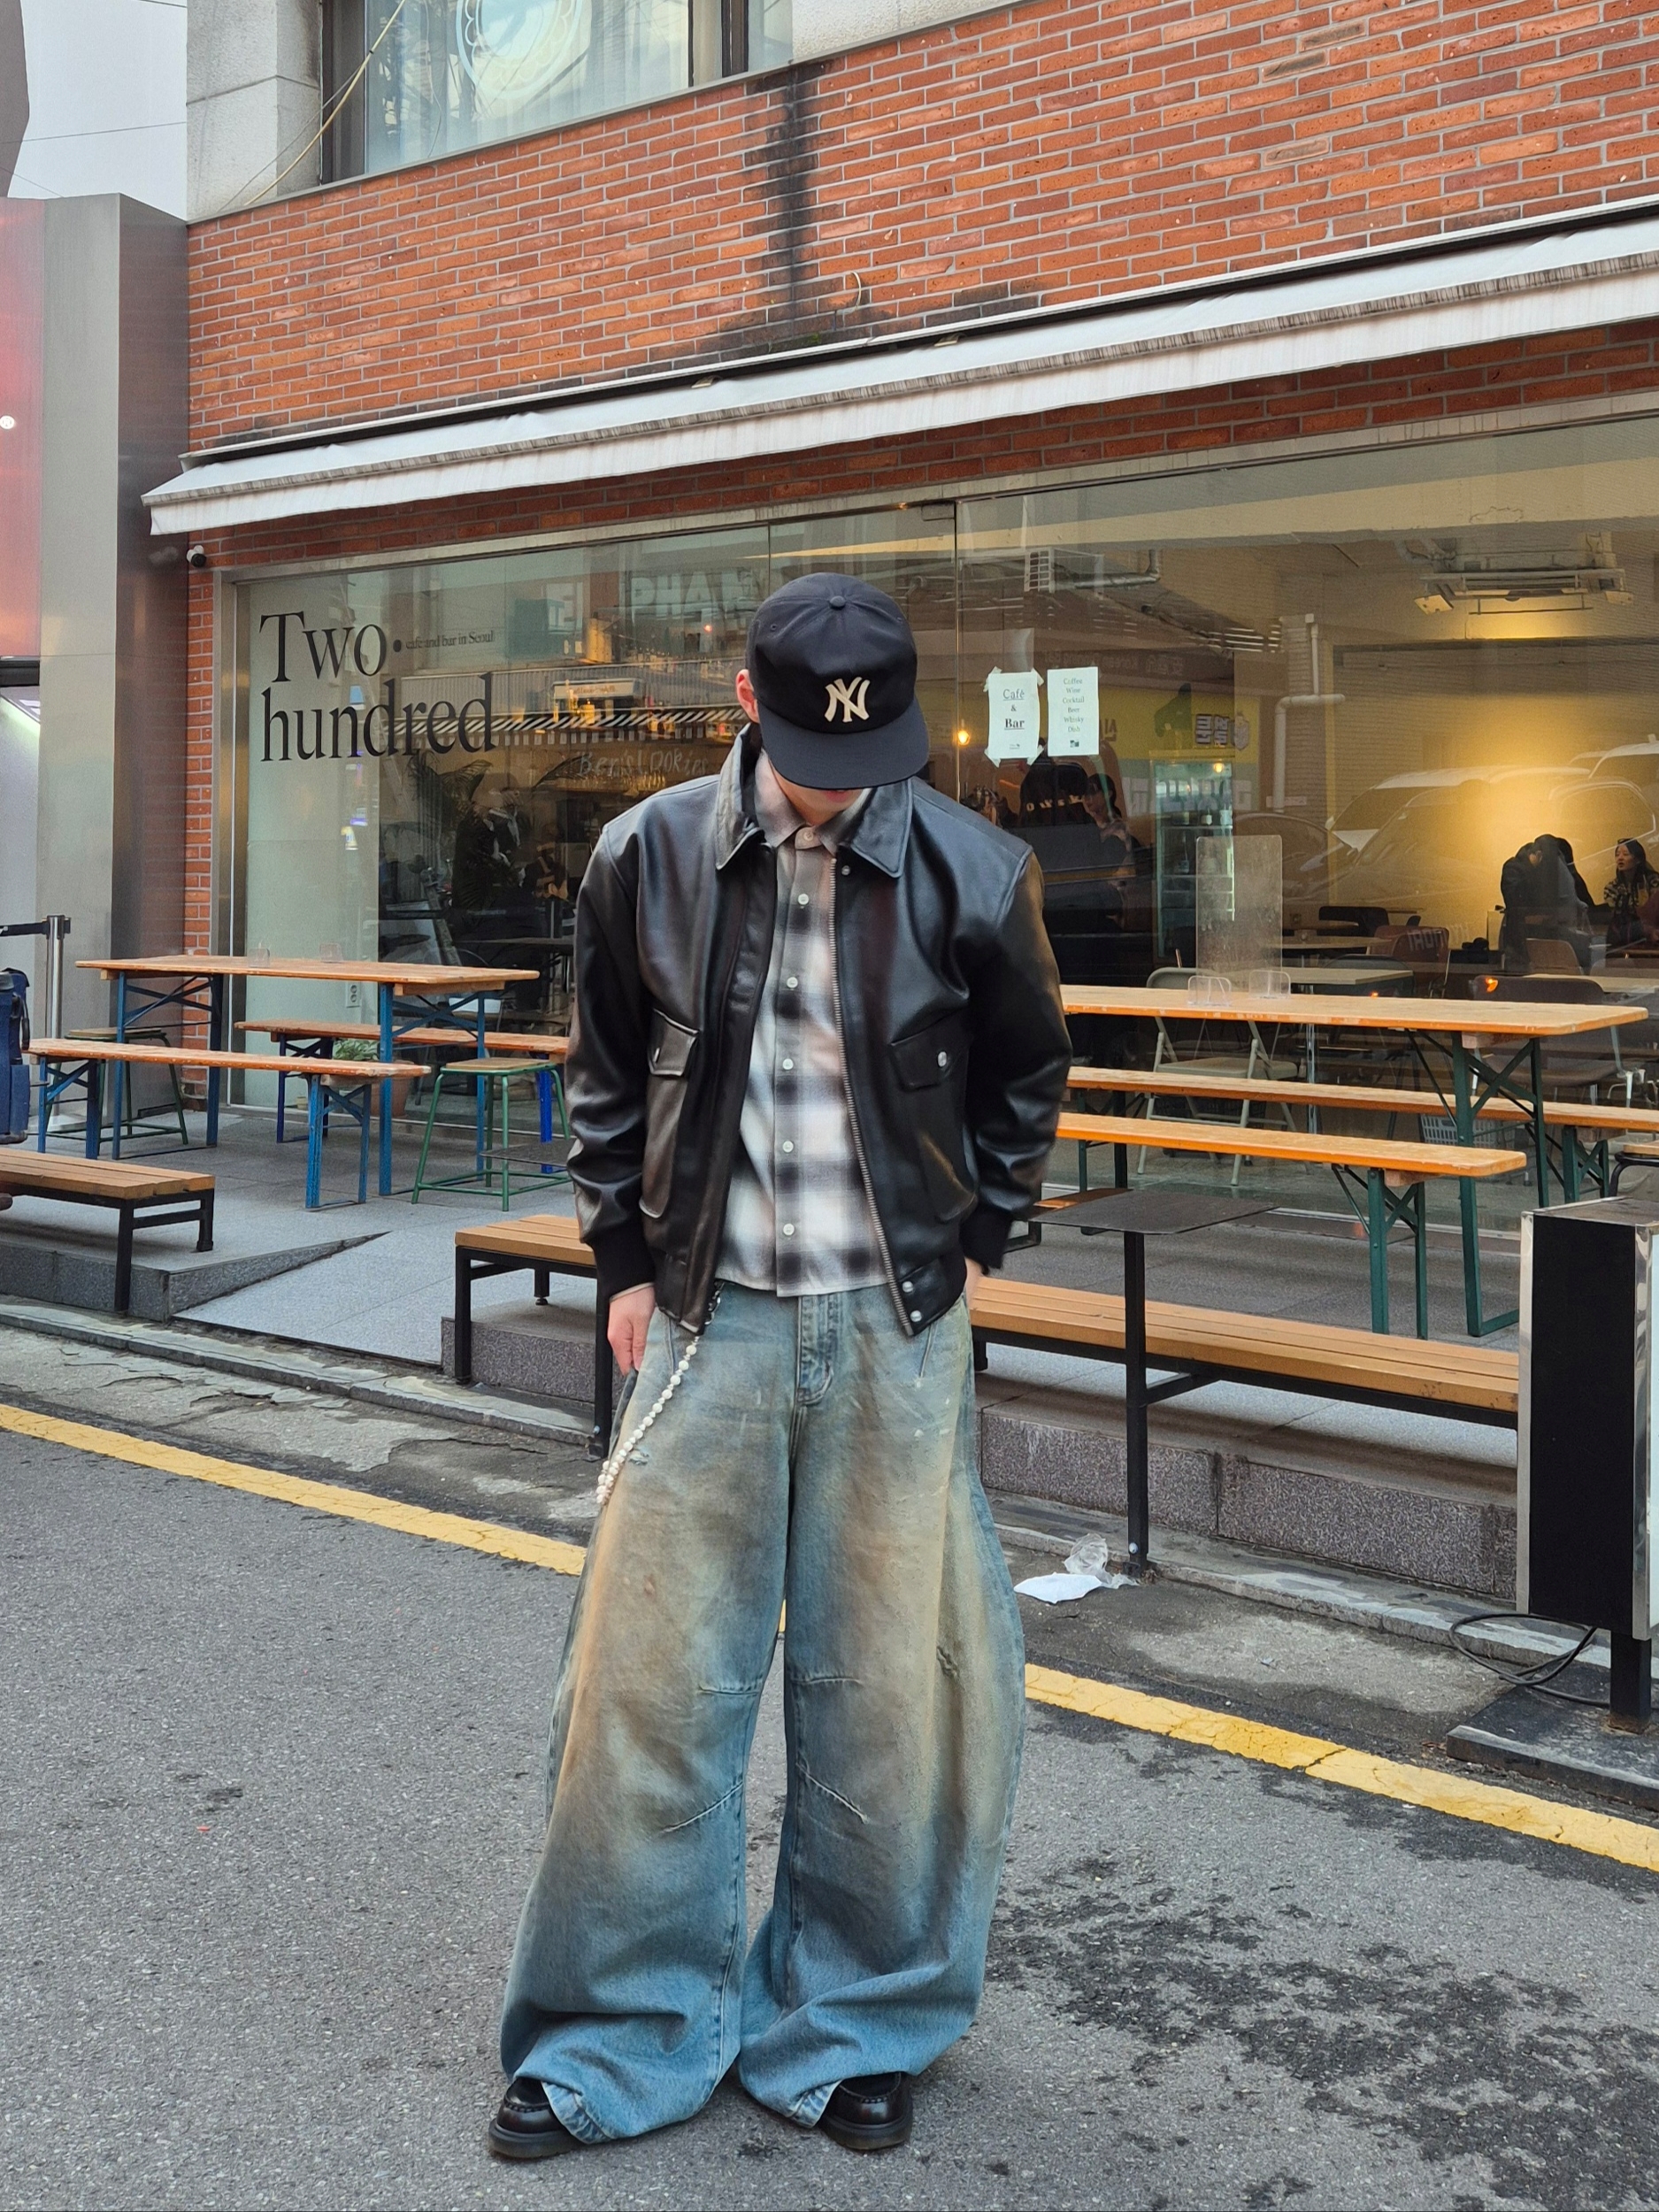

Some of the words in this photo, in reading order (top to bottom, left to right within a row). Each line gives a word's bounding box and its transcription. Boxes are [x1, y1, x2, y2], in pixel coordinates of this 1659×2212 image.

[259, 611, 387, 683] Two
[424, 634, 442, 648] and
[442, 634, 456, 647] bar
[457, 633, 467, 645] in
[468, 630, 495, 644] Seoul
[824, 676, 871, 723] NY
[1002, 688, 1025, 700] Café
[1062, 695, 1085, 704] Cocktail
[260, 671, 496, 762] hundred
[1005, 718, 1025, 729] Bar
